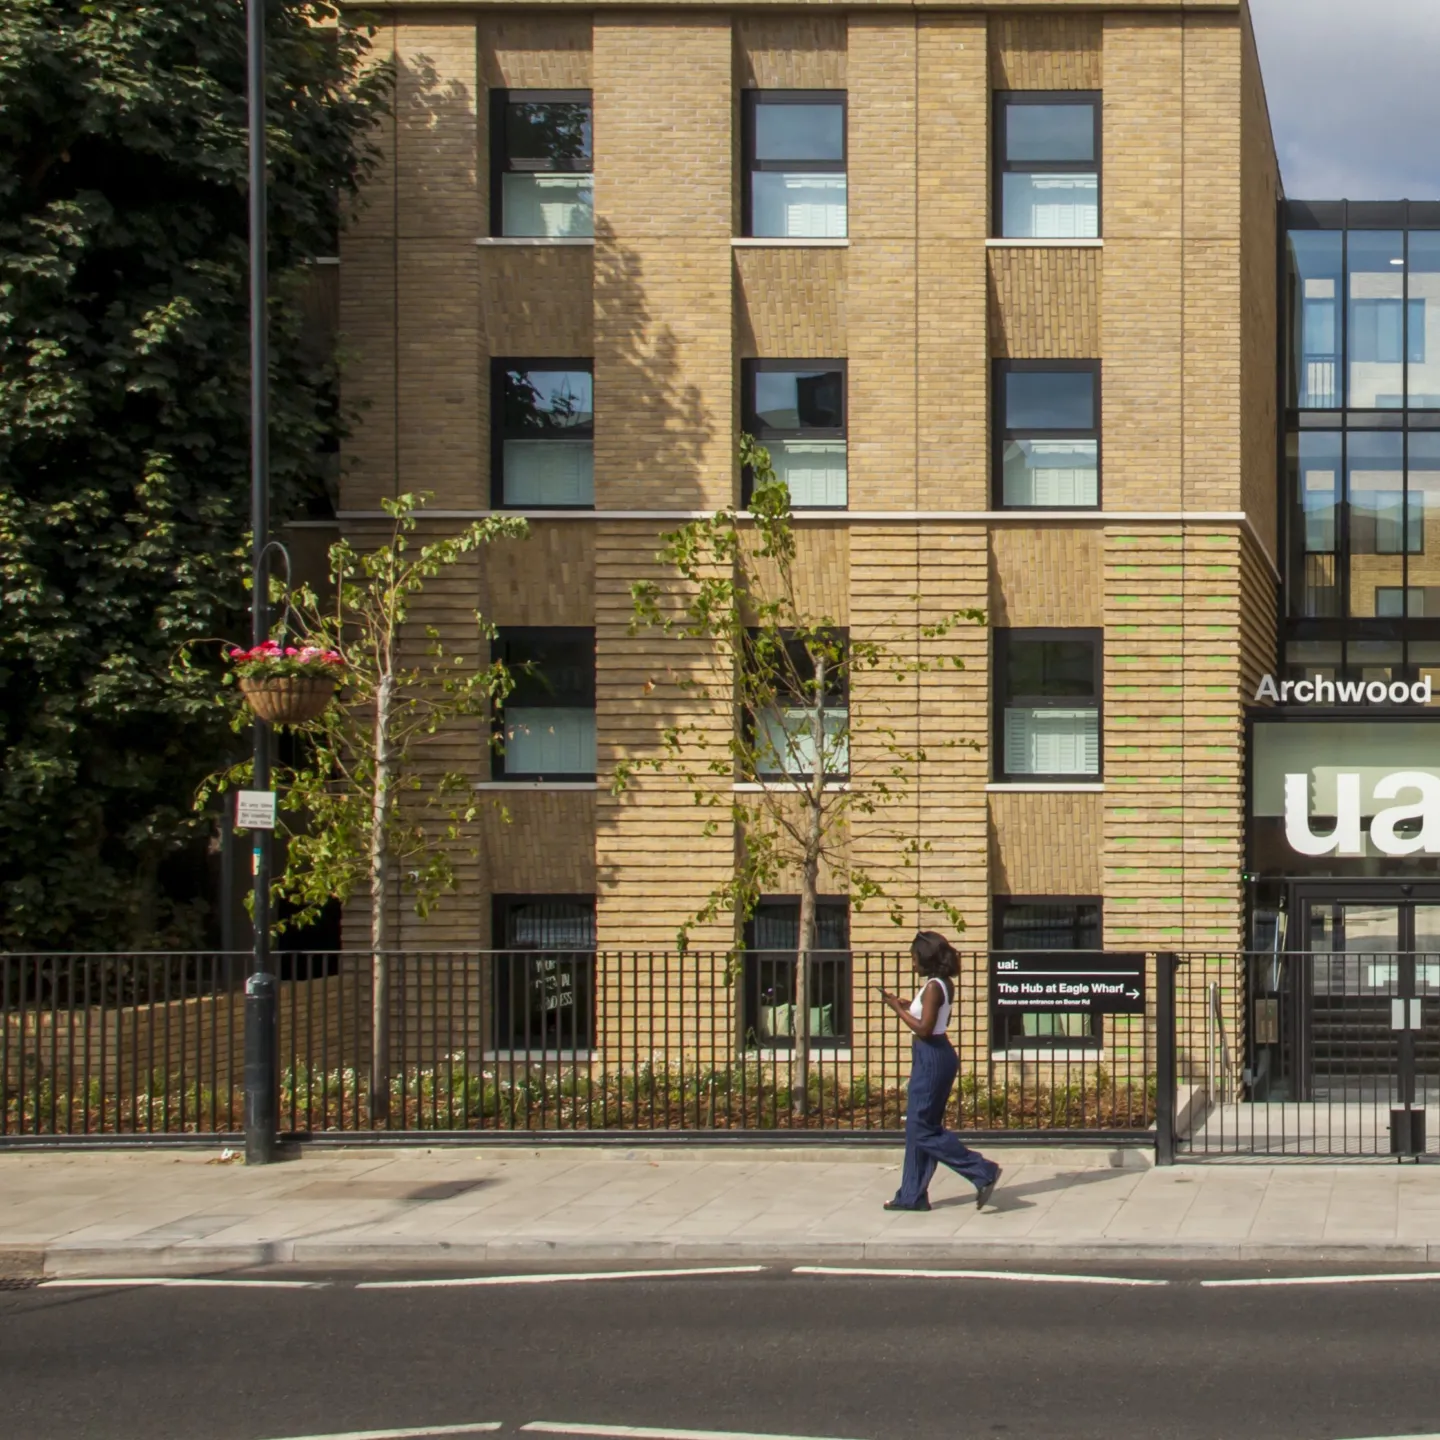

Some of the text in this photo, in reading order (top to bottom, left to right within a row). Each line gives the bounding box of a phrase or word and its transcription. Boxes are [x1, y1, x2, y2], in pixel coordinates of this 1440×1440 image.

[1254, 674, 1431, 703] Archwood
[997, 959, 1019, 970] ual:
[997, 982, 1124, 996] The Hub at Eagle Wharf
[997, 998, 1017, 1006] Please
[1029, 998, 1054, 1006] entrance
